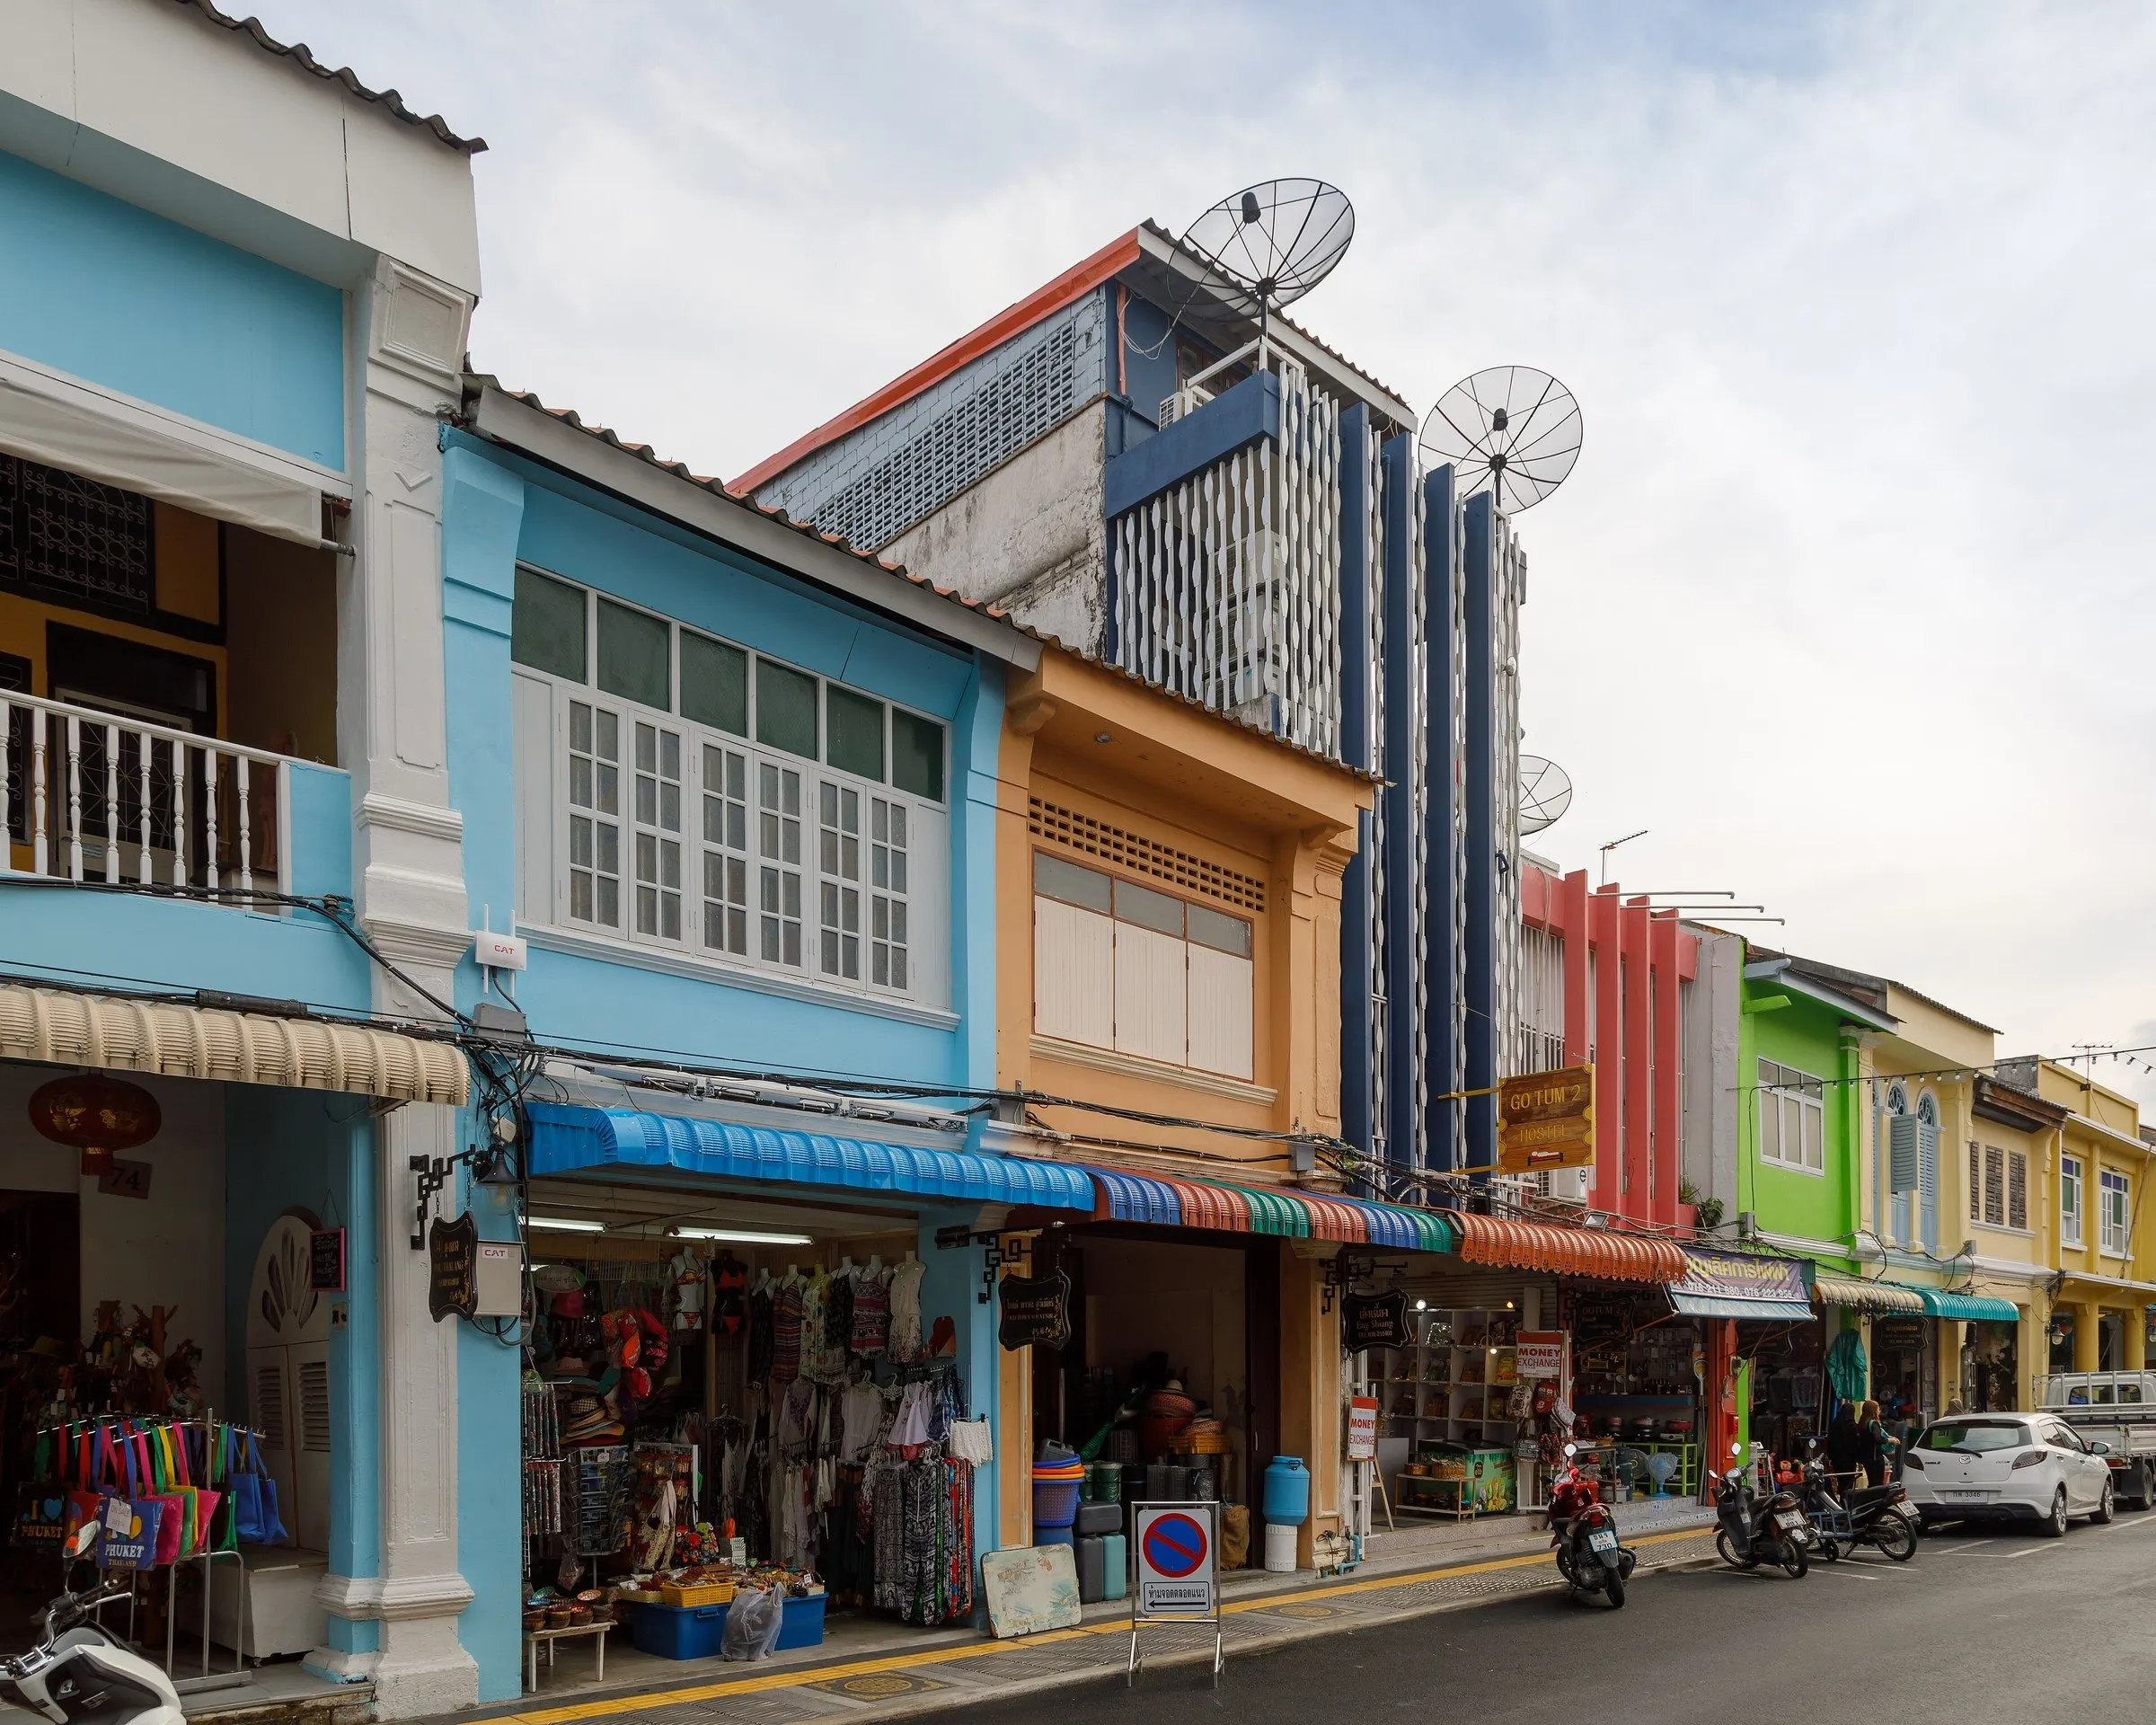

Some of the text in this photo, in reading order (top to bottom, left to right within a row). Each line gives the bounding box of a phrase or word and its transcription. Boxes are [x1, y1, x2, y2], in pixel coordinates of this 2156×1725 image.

[494, 945, 515, 955] CAT
[1510, 1084, 1581, 1110] GO TUM 2
[111, 1166, 141, 1190] 74
[484, 1249, 506, 1257] CAT
[1745, 1287, 1760, 1297] 076
[1356, 1319, 1394, 1331] Eng Shiang
[1517, 1348, 1561, 1358] MONEY
[1516, 1358, 1561, 1368] EXCHANGE
[1350, 1418, 1375, 1429] MONEY
[1349, 1434, 1375, 1446] EXCHANGE
[21, 1525, 64, 1539] PHUKET
[104, 1544, 145, 1559] PHUKET
